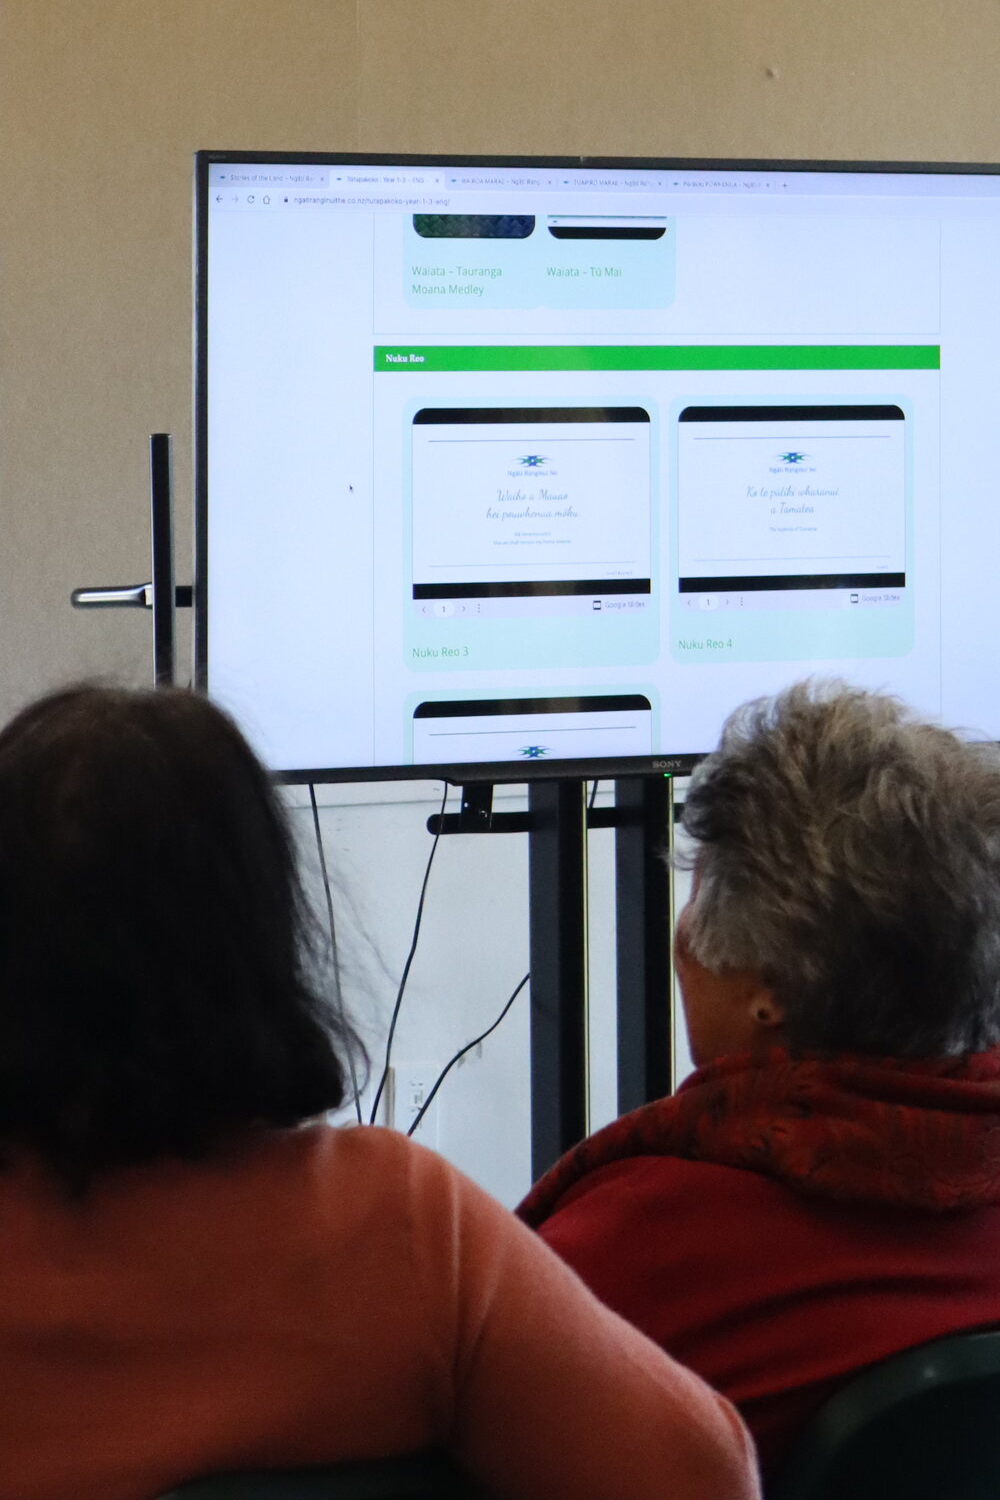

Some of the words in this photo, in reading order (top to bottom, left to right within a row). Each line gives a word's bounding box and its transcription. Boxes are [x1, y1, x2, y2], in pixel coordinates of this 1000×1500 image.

[412, 266, 446, 276] Waiata
[457, 266, 503, 279] Tauranga
[546, 267, 580, 277] Waiata
[604, 267, 622, 277] Mai
[412, 284, 446, 295] Moana
[448, 284, 485, 297] Medley
[385, 354, 408, 363] Nuku
[409, 354, 425, 363] Reo
[605, 601, 626, 610] Google
[678, 640, 704, 650] Nuku
[706, 639, 724, 649] Reo
[726, 638, 733, 649] 4
[412, 647, 439, 658] Nuku
[441, 647, 460, 658] Reo
[462, 646, 469, 657] 3
[652, 760, 682, 769] SONY
